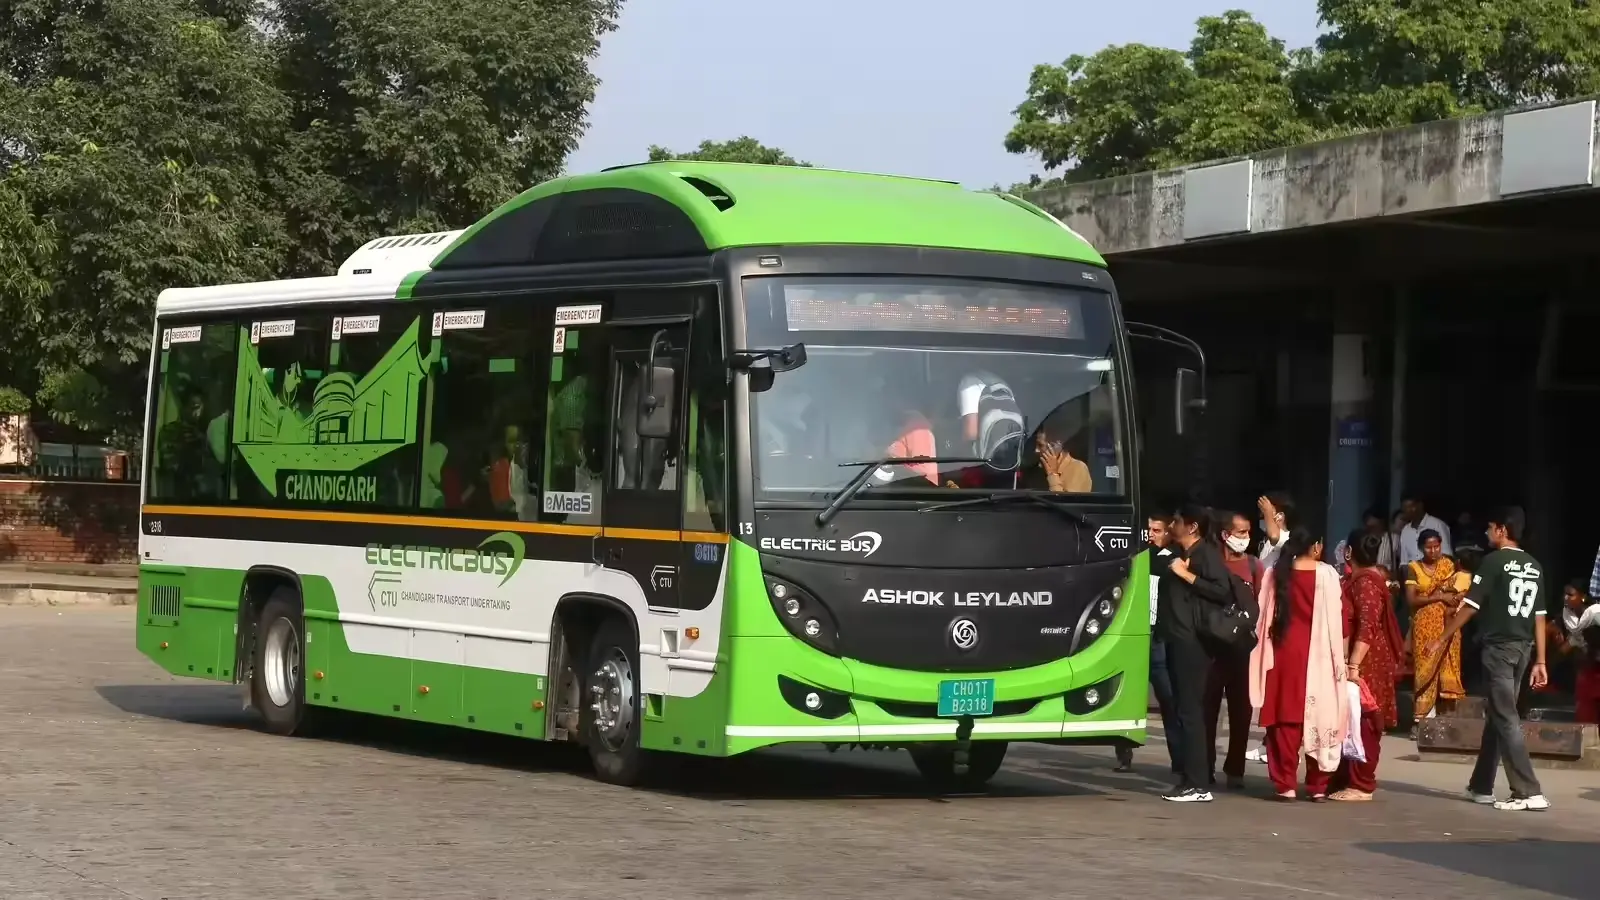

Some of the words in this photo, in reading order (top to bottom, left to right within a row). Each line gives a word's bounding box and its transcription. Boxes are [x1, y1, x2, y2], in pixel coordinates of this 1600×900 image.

[444, 313, 473, 326] EMERGENCY
[472, 313, 484, 324] EXIT
[556, 310, 589, 321] EMERGENCY
[588, 308, 600, 319] EXIT
[261, 325, 286, 334] EMERGENCY
[284, 323, 294, 333] EXIT
[343, 320, 369, 330] EMERGENCY
[368, 319, 379, 328] EXIT
[171, 331, 193, 340] EMERGENCY
[191, 329, 201, 338] EXIT
[285, 474, 377, 502] CHANDIGARH
[545, 493, 591, 512] eMaaS
[150, 520, 162, 533] 2318
[739, 522, 753, 535] 13
[1140, 529, 1149, 541] 13
[760, 537, 836, 551] ELECTRIC
[840, 540, 871, 552] BUS
[1110, 538, 1128, 549] CTU
[659, 577, 672, 588] CTU
[381, 591, 398, 607] CTU
[401, 591, 436, 604] CHANDIGARH
[436, 594, 470, 607] TRANSPORT
[470, 598, 511, 611] UNDERTAKING
[862, 588, 944, 606] ASHOK
[954, 591, 1053, 607] LEYLAND
[1507, 577, 1539, 619] 93
[953, 680, 989, 697] CH01T
[952, 698, 987, 713] B2318
